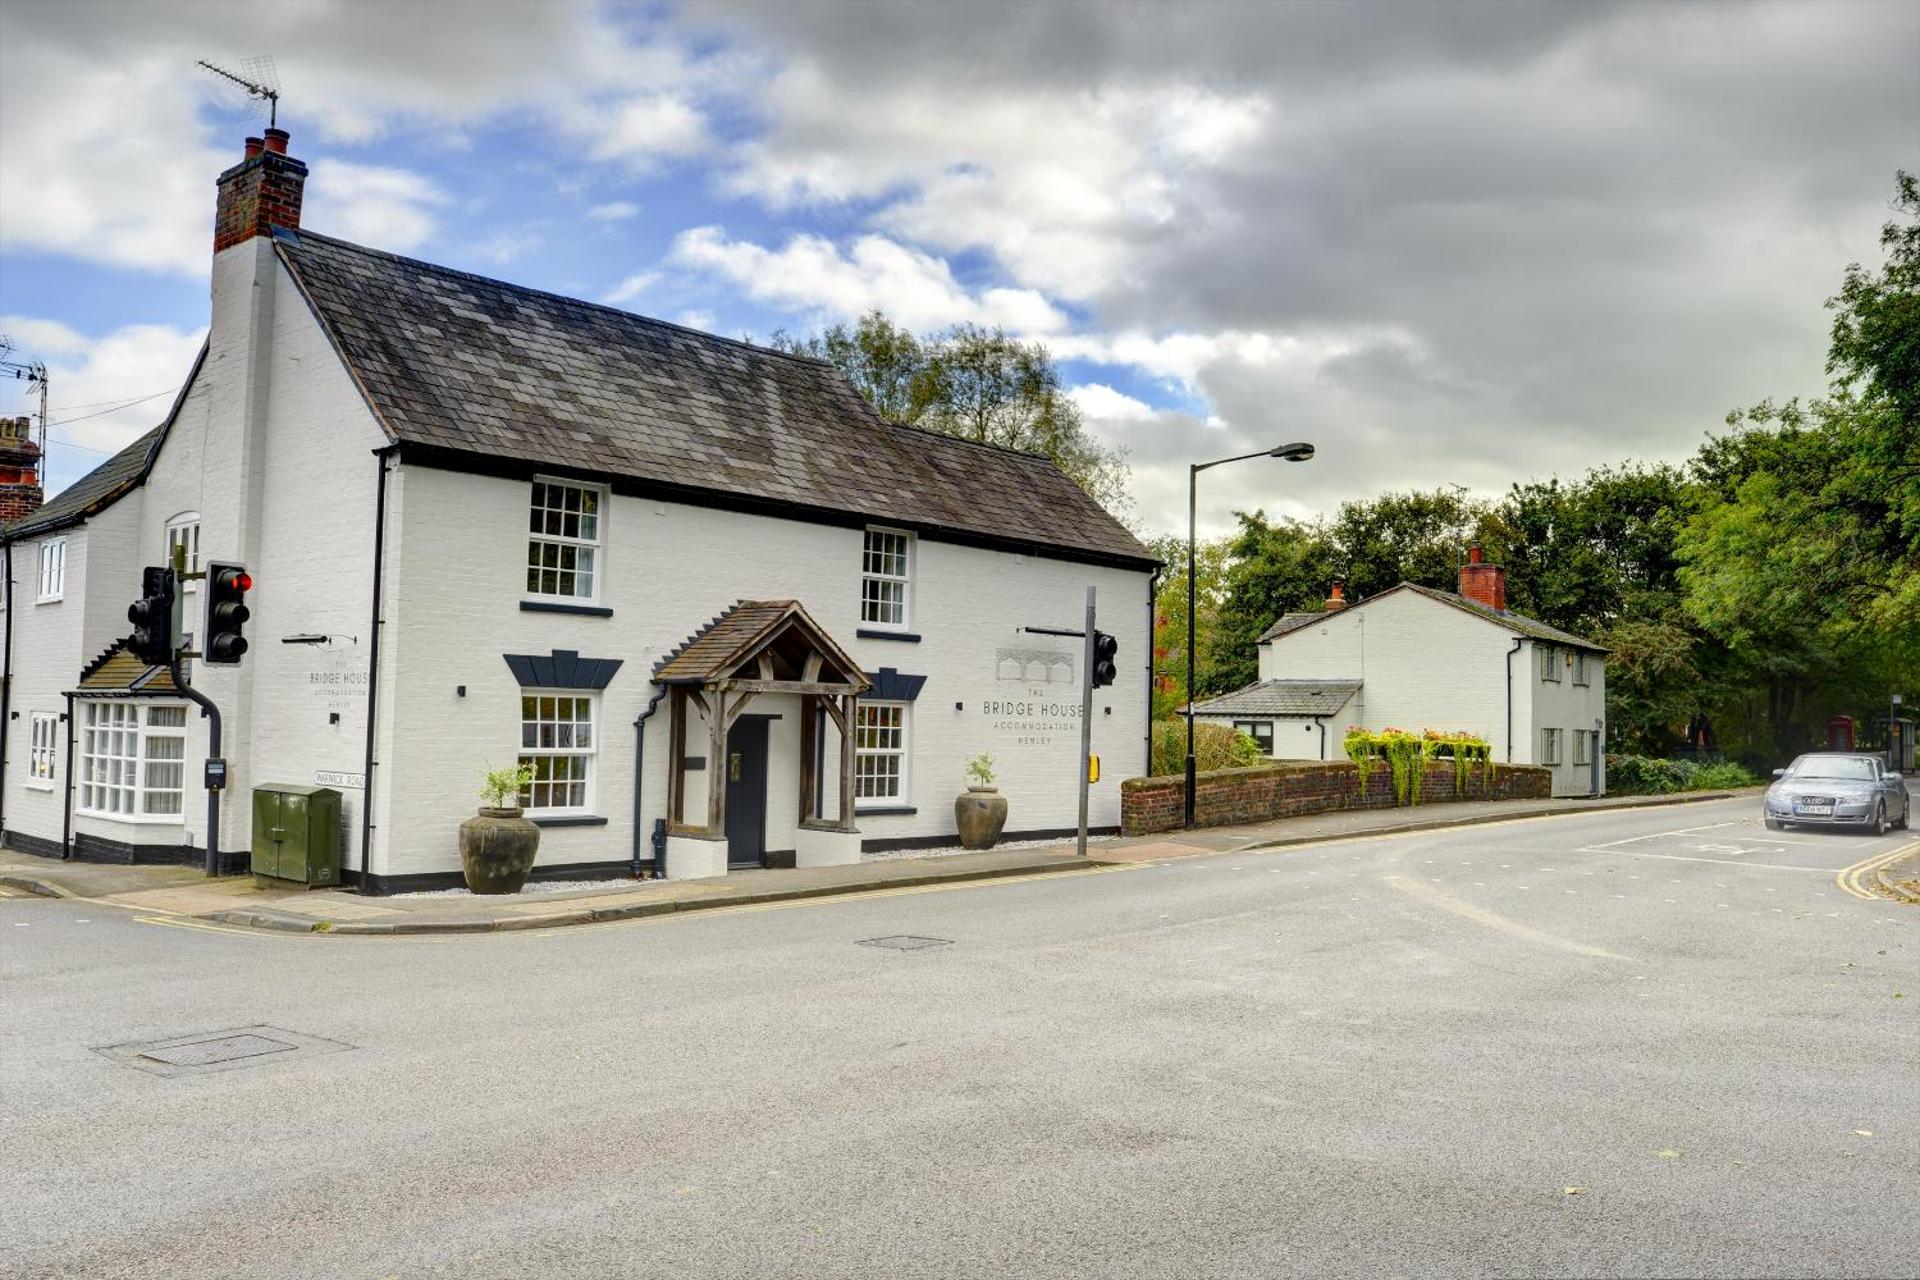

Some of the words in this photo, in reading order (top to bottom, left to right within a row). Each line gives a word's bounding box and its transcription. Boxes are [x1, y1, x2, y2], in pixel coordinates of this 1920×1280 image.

[343, 672, 368, 685] HOUS
[1028, 688, 1044, 697] THE
[983, 701, 1033, 716] BRIDGE
[1041, 704, 1084, 718] HOUSE
